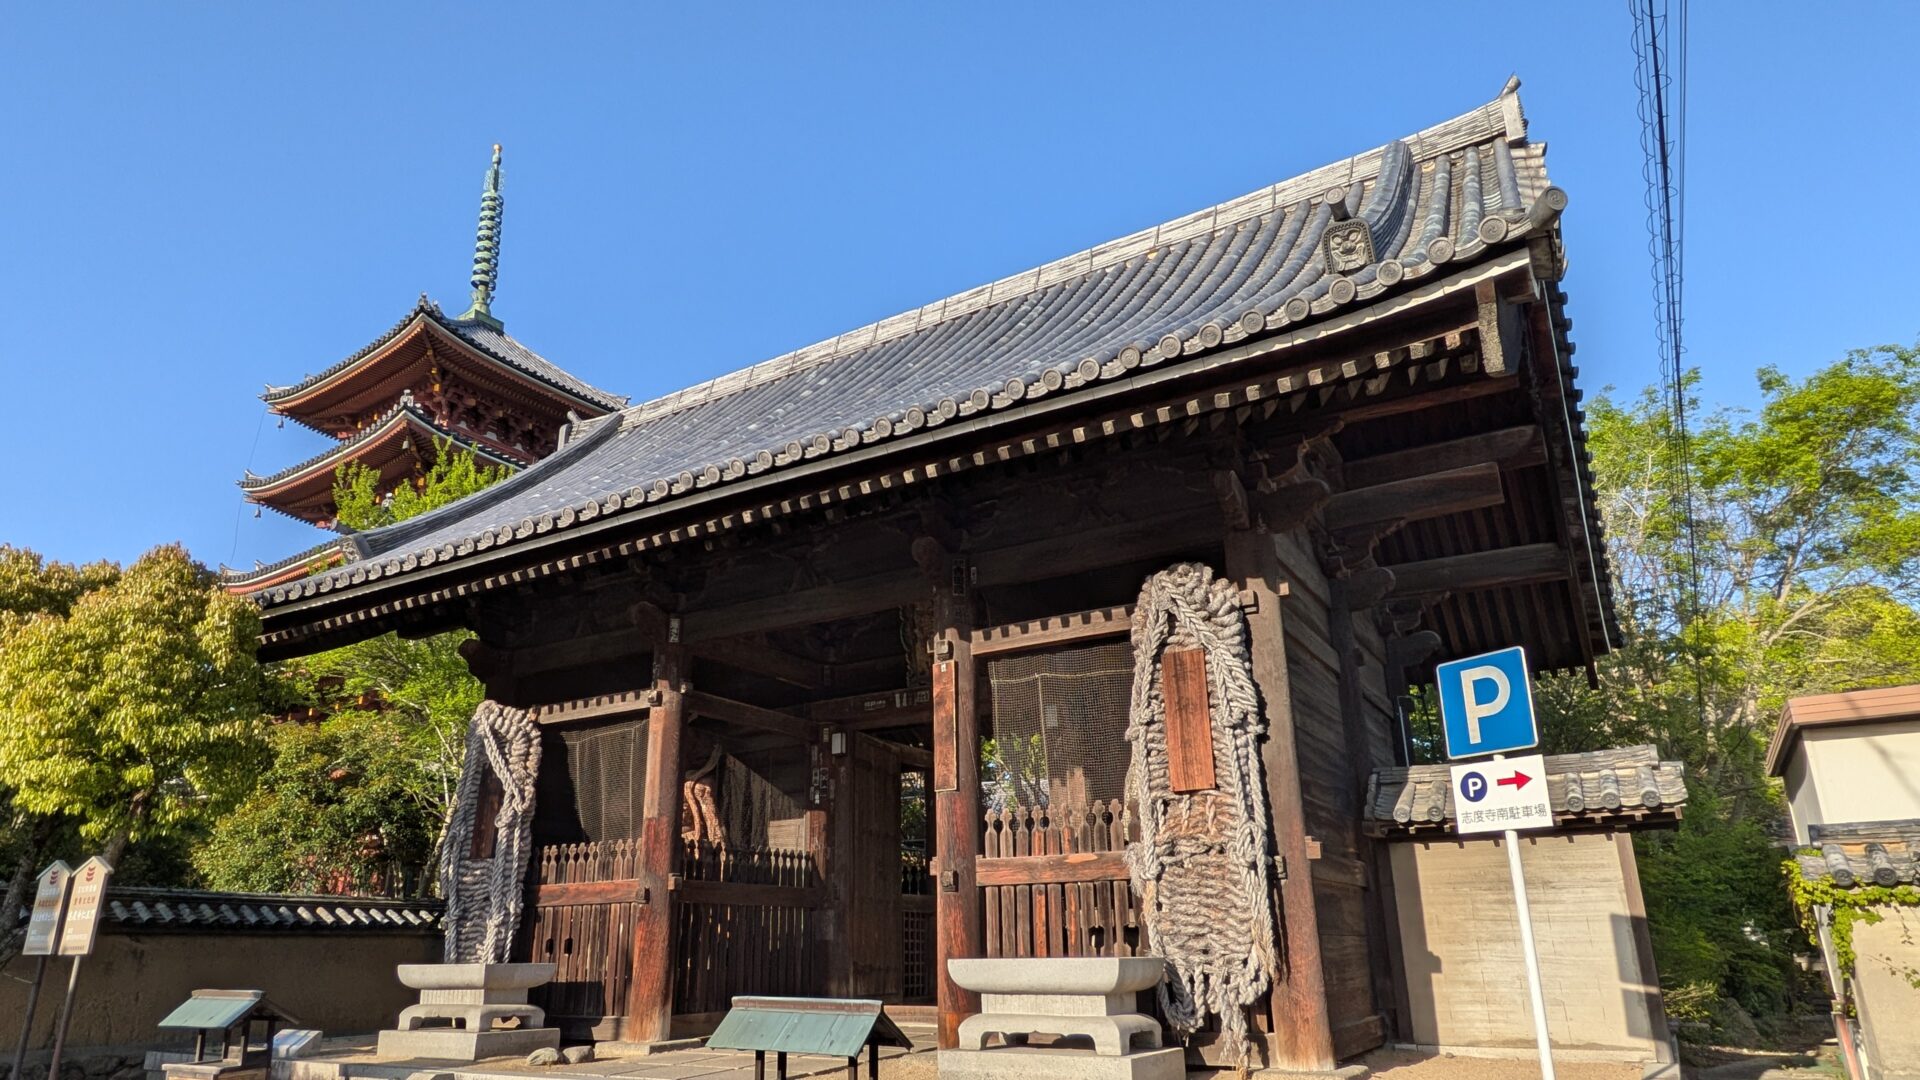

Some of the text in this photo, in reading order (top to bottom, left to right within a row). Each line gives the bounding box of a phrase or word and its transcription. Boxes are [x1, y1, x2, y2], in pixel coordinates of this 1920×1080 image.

[1460, 665, 1511, 745] P
[1468, 777, 1482, 798] P
[1461, 803, 1548, 824] 志度寺南駐車場
